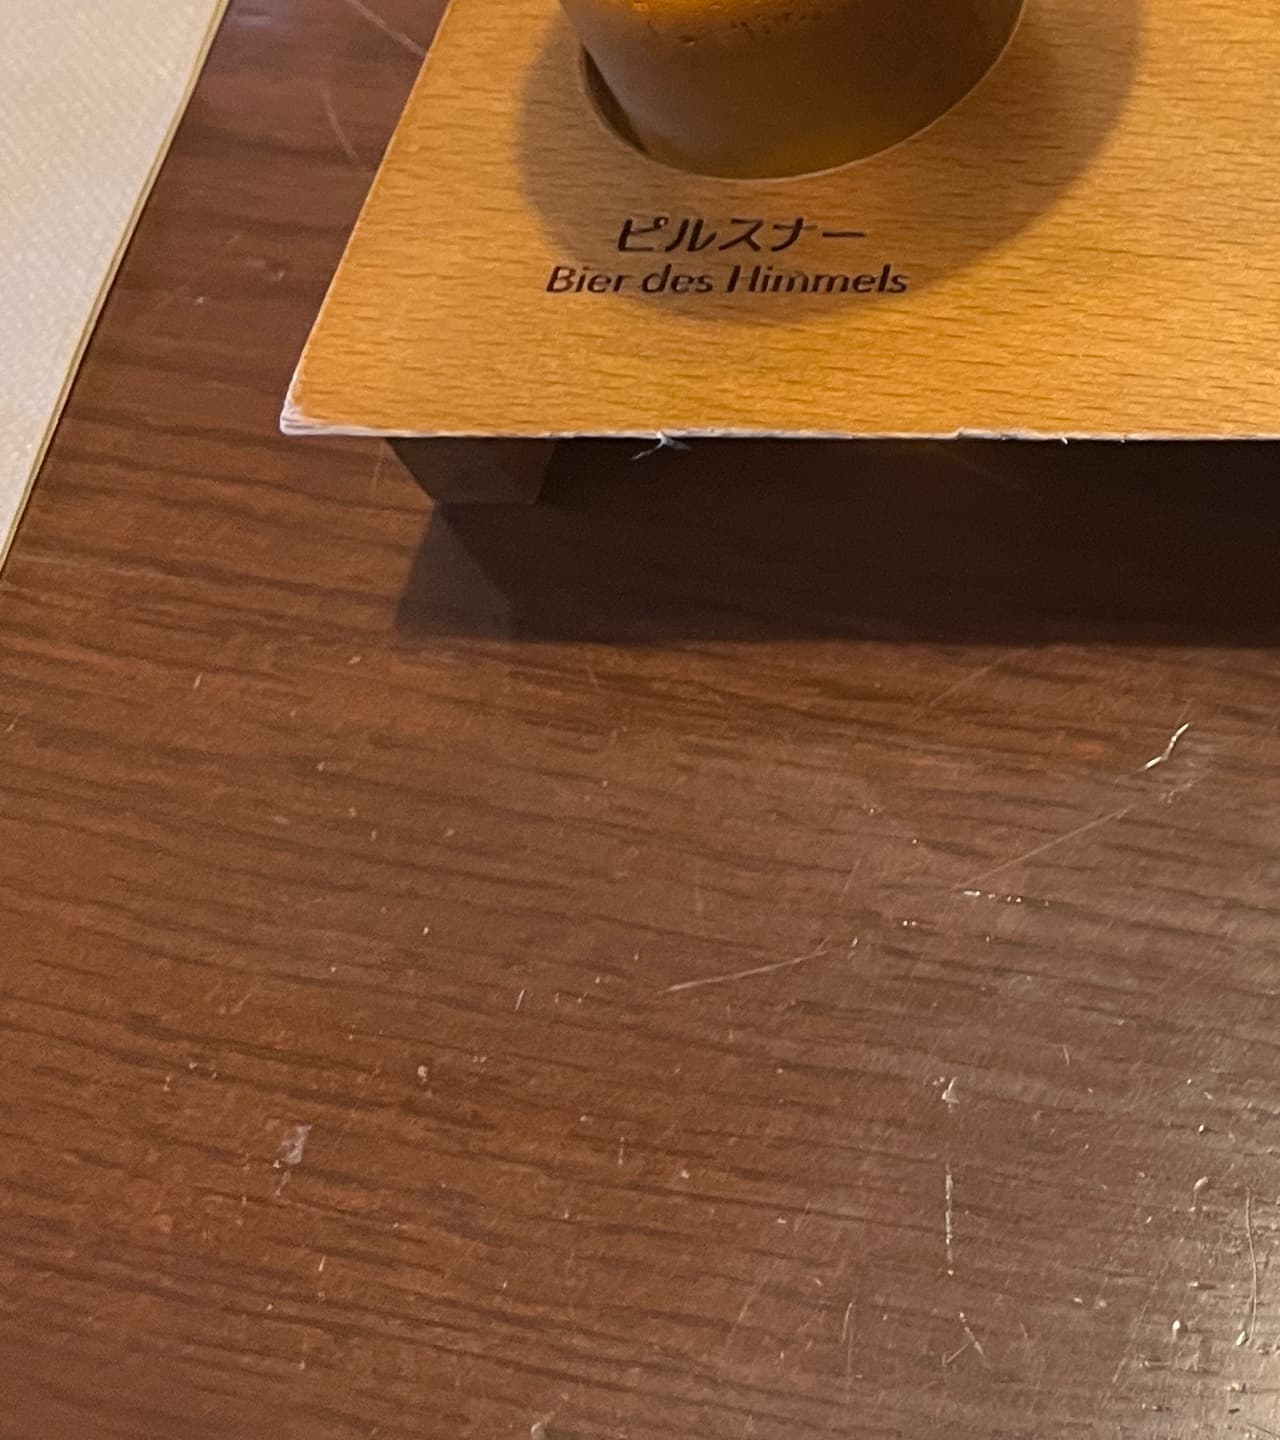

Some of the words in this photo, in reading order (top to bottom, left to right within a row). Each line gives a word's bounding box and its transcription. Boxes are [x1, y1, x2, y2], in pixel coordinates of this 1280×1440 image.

[616, 217, 866, 253] ピルスナー
[546, 264, 633, 293] Bier
[641, 264, 718, 293] des
[727, 264, 908, 294] Himmels
